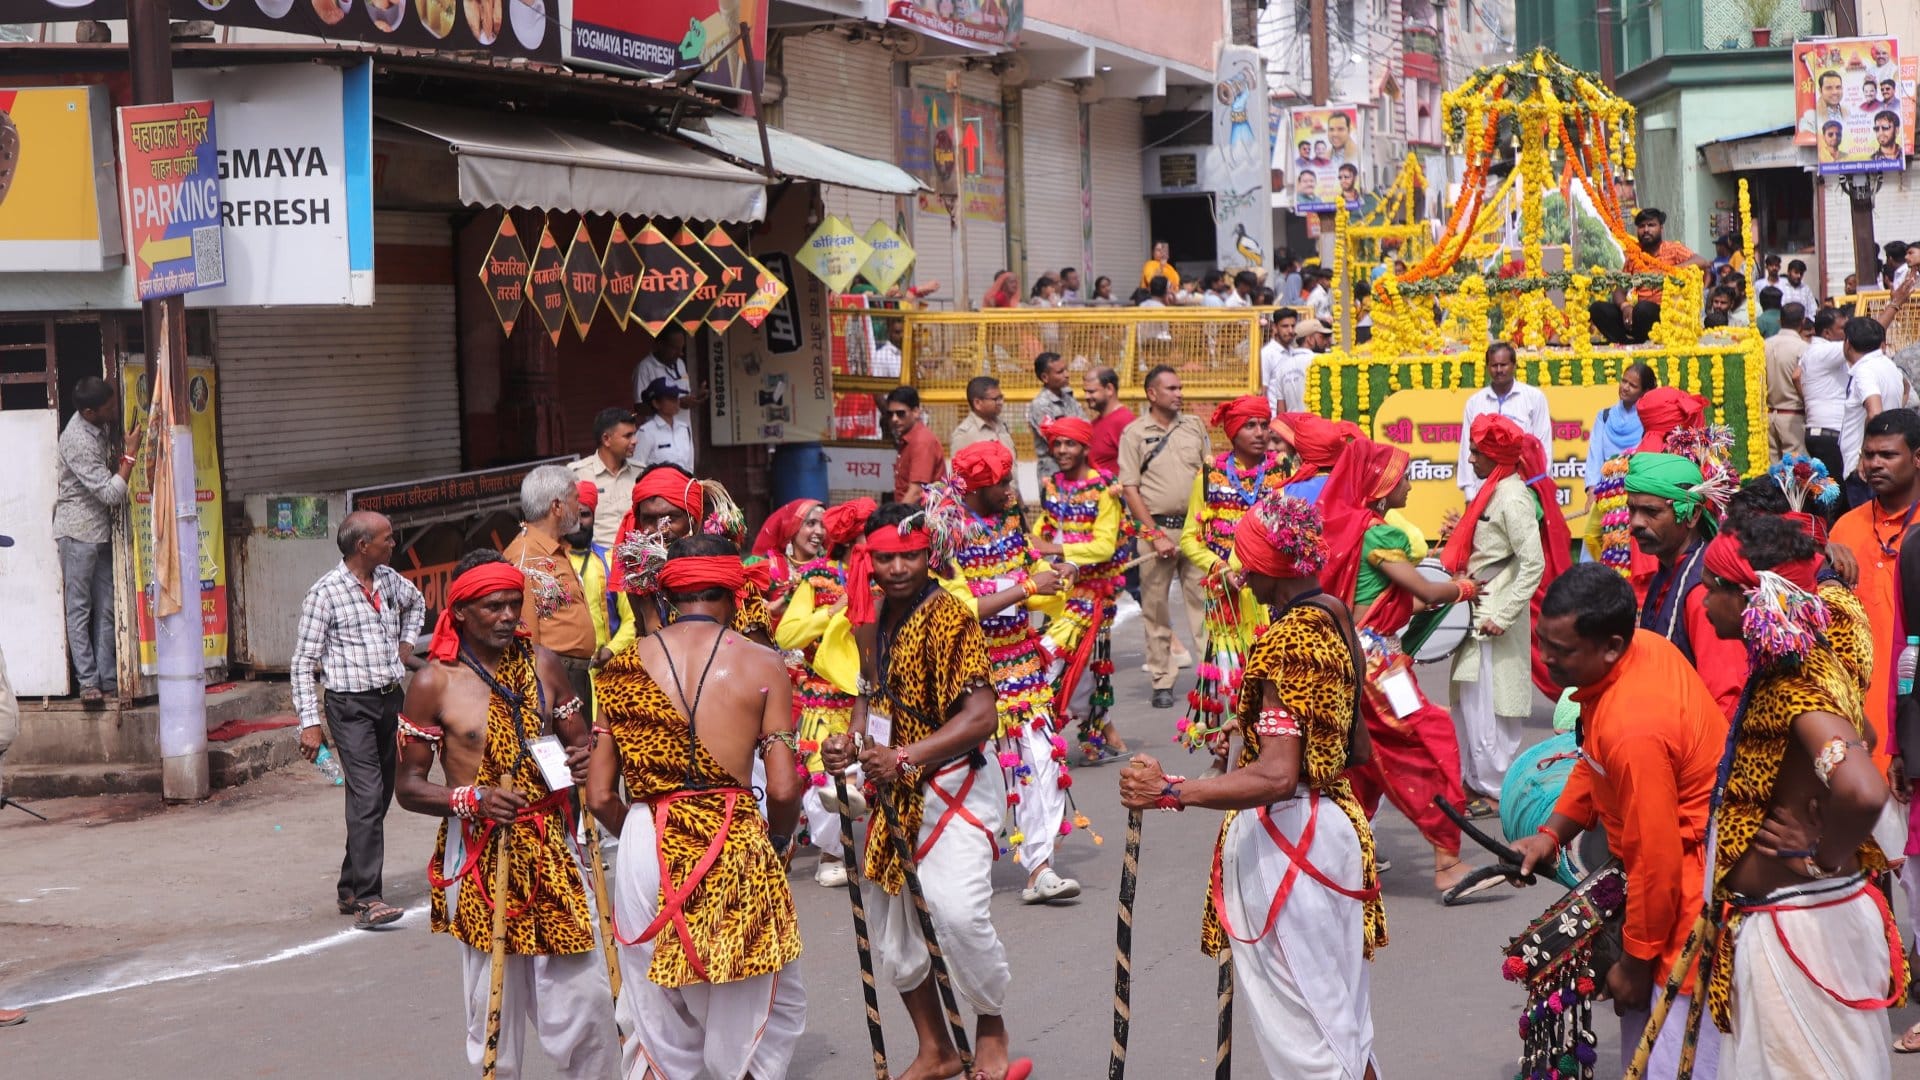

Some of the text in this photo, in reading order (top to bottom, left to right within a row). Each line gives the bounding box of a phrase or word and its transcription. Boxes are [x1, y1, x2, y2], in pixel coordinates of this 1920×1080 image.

[576, 27, 622, 55] YOGMAYA
[623, 39, 675, 67] EVERFRESH
[130, 108, 209, 153] महाकाल मंदिर
[151, 158, 172, 181] वाहन
[133, 178, 217, 229] PARKING
[491, 256, 526, 277] केसरिया
[497, 281, 521, 300] लस्सी
[572, 271, 597, 294] चाय
[610, 272, 634, 295] पोहा
[545, 293, 561, 309] छाछ
[810, 323, 825, 351] और
[1384, 416, 1413, 443] श्री
[845, 461, 882, 479] मध्य
[1408, 459, 1454, 480] र्मिक
